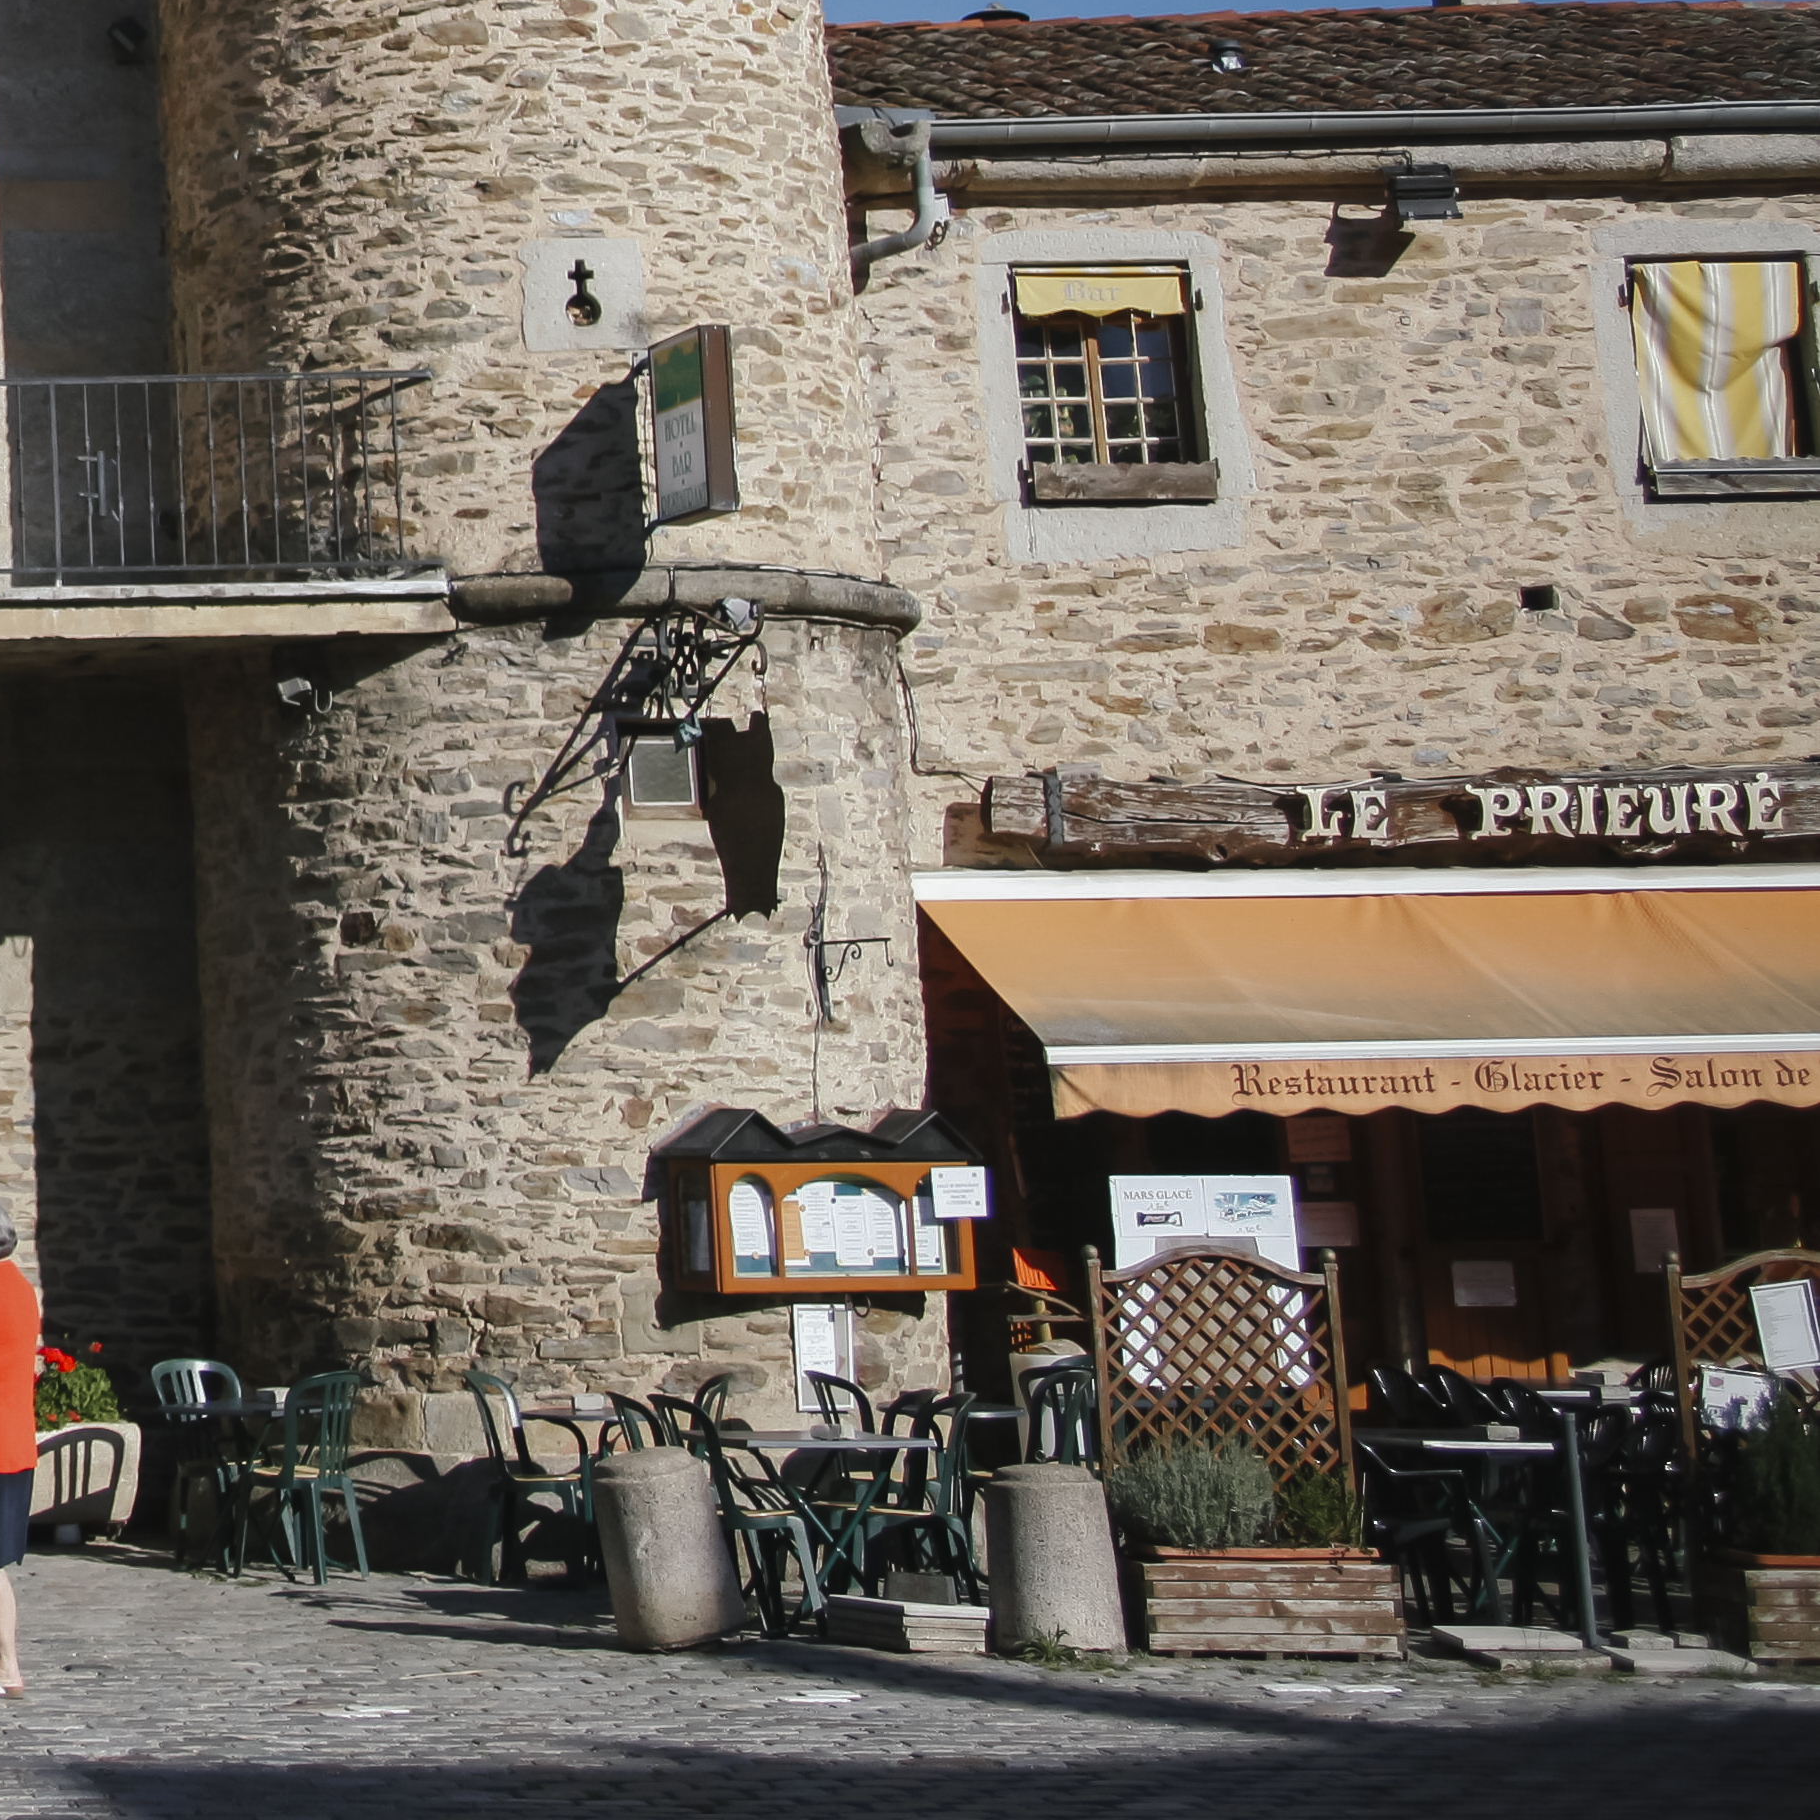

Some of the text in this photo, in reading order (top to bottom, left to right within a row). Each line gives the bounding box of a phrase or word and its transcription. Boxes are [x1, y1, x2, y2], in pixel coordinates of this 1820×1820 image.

[1062, 280, 1121, 302] Bar
[664, 411, 697, 443] HOTEL
[672, 450, 693, 479] BAR
[1296, 772, 1785, 842] LE PRIEURÉ
[1230, 1063, 1437, 1106] Restaurant
[1474, 1059, 1605, 1093] Glacier
[1646, 1056, 1763, 1097] Salon
[1774, 1058, 1812, 1087] de
[1123, 1188, 1193, 1200] MARS GLACÉ
